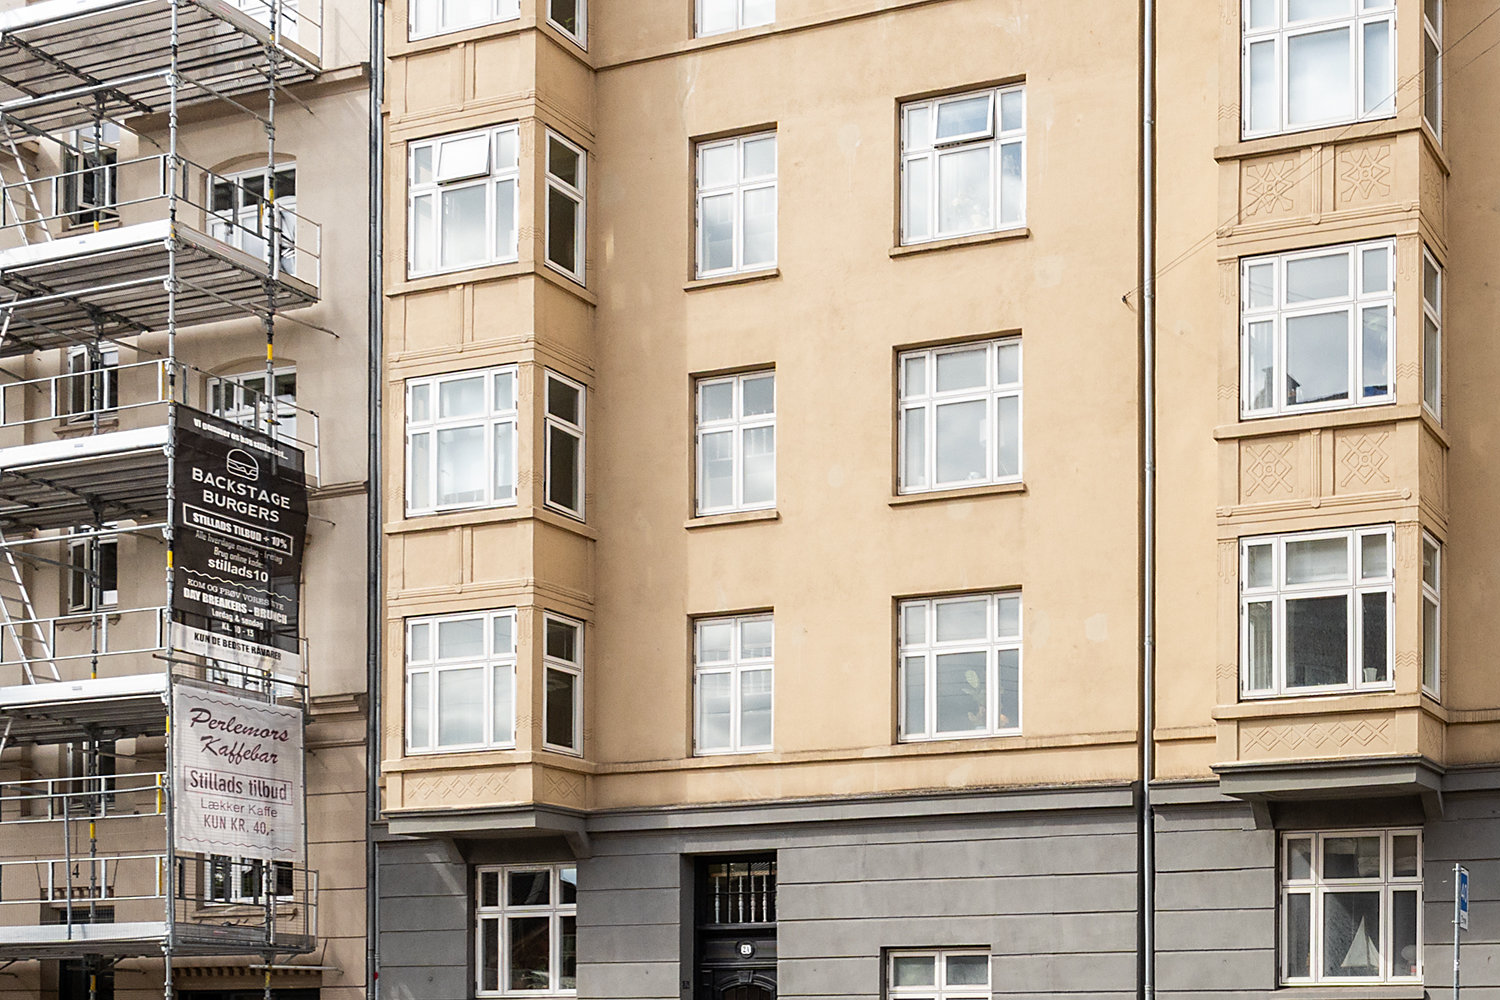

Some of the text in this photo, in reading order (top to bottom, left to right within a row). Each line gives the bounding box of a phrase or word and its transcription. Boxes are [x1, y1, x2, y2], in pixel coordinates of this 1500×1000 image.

[192, 467, 290, 509] BACKSTAGE
[203, 490, 280, 522] BURGERS
[193, 512, 232, 533] STILLADS
[233, 524, 262, 542] TILBUD
[271, 536, 287, 549] 10%
[214, 546, 228, 559] Brug
[208, 558, 268, 582] stillads10
[188, 579, 205, 590] KOM
[207, 584, 218, 592] OG
[183, 587, 201, 601] DAY
[202, 592, 247, 614] BREAKERS
[254, 606, 287, 624] BRUNCH
[194, 632, 281, 660] KUN DE BEDSTE RÅVARER
[190, 707, 290, 742] Perlemors
[200, 735, 278, 765] Kaffebar
[190, 770, 287, 800] Stillads tilbud
[200, 798, 278, 818] Lækker Kaffe
[204, 814, 275, 836] KUN KR. 40,-
[72, 863, 80, 878] 4
